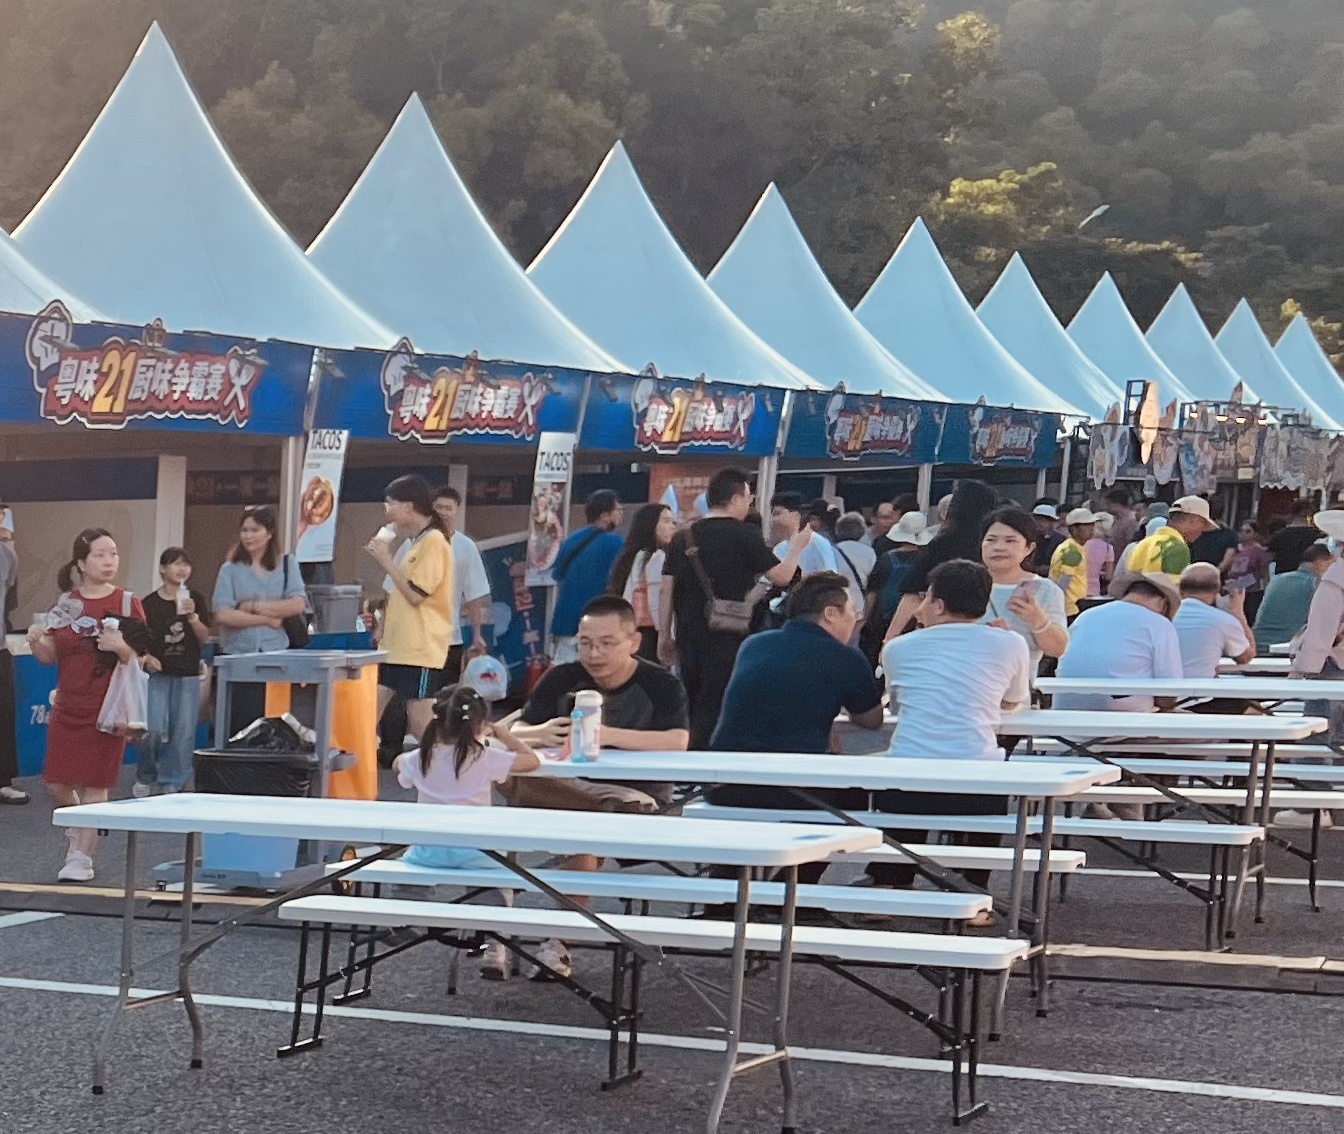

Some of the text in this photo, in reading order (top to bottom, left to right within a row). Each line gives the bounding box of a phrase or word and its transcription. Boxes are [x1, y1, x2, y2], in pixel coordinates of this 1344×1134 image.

[54, 349, 226, 413] 粤味21厨味争霸赛
[311, 429, 343, 450] TACOS
[539, 451, 571, 471] TACOS
